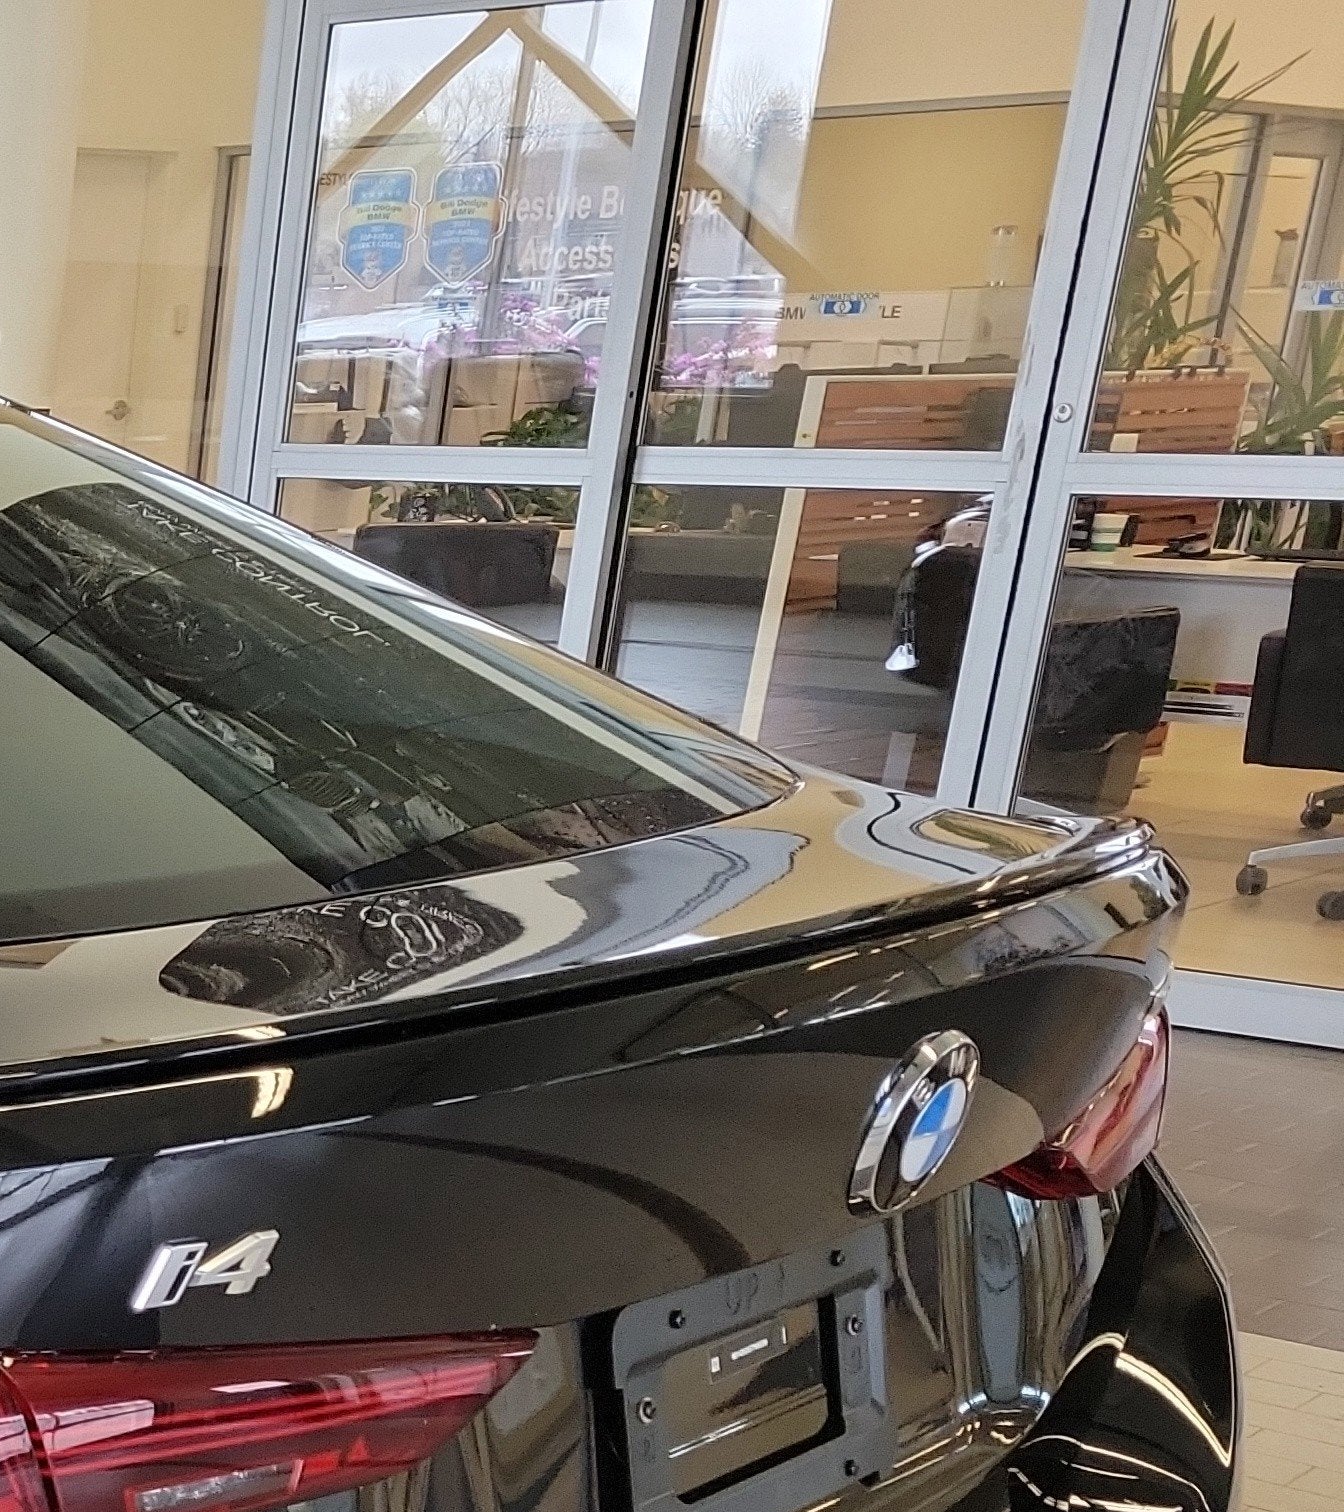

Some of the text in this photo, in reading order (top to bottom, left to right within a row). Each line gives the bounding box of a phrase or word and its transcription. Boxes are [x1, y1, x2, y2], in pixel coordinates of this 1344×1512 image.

[810, 291, 880, 301] AUTOMATIC DOOR
[132, 1229, 281, 1313] i4
